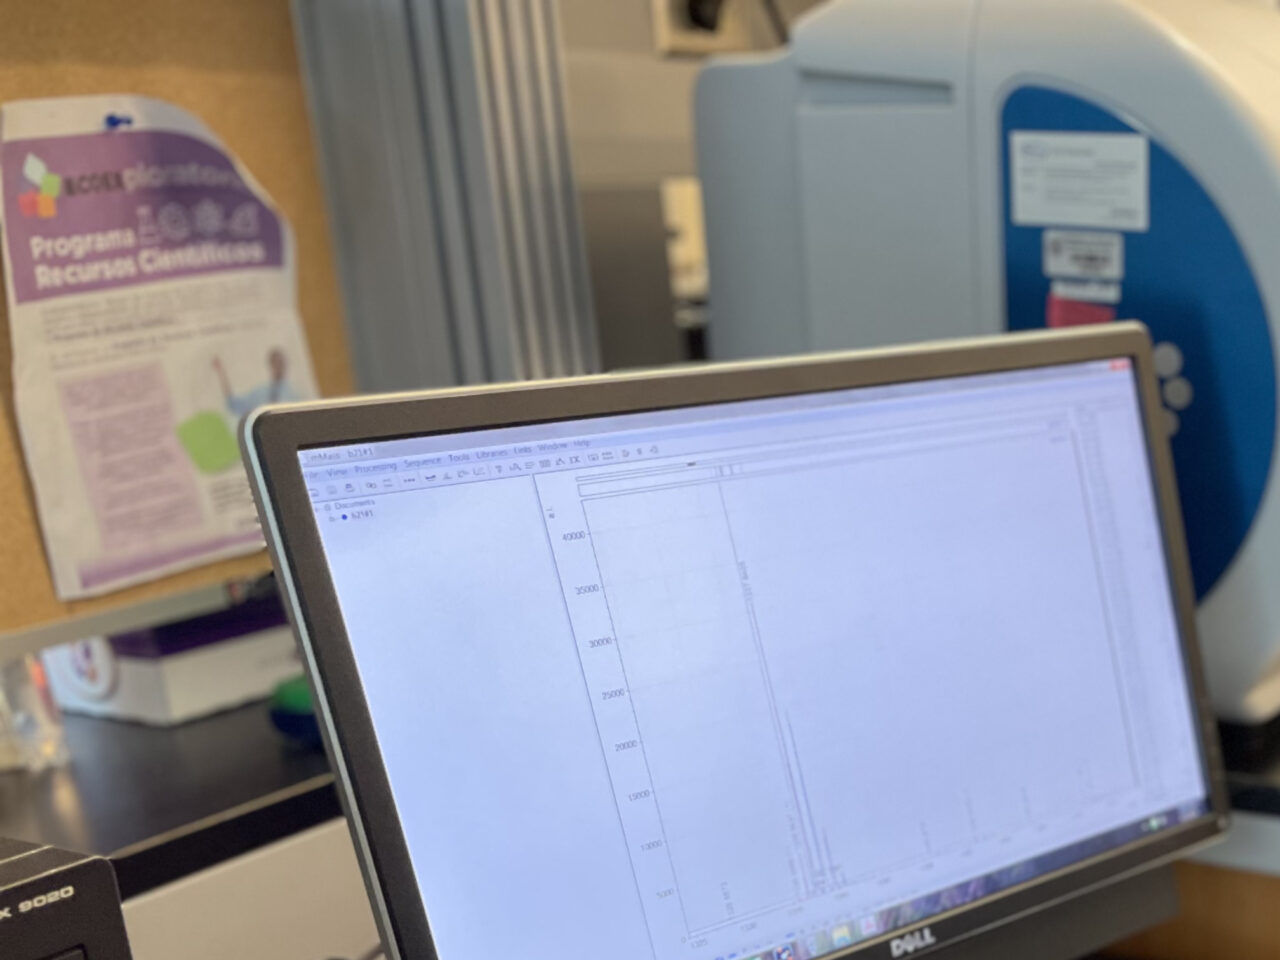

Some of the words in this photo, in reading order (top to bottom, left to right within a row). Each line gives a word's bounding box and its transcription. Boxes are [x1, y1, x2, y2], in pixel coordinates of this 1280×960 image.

[30, 228, 136, 259] Programa
[35, 257, 137, 290] Recursos
[353, 462, 398, 475] Processing
[404, 456, 442, 468] Sequence
[448, 453, 470, 463] Tools
[334, 498, 376, 511] Documents
[562, 530, 586, 542] 40000
[575, 583, 600, 595] 35000
[18, 885, 75, 913] 9020
[890, 927, 936, 958] DELL
